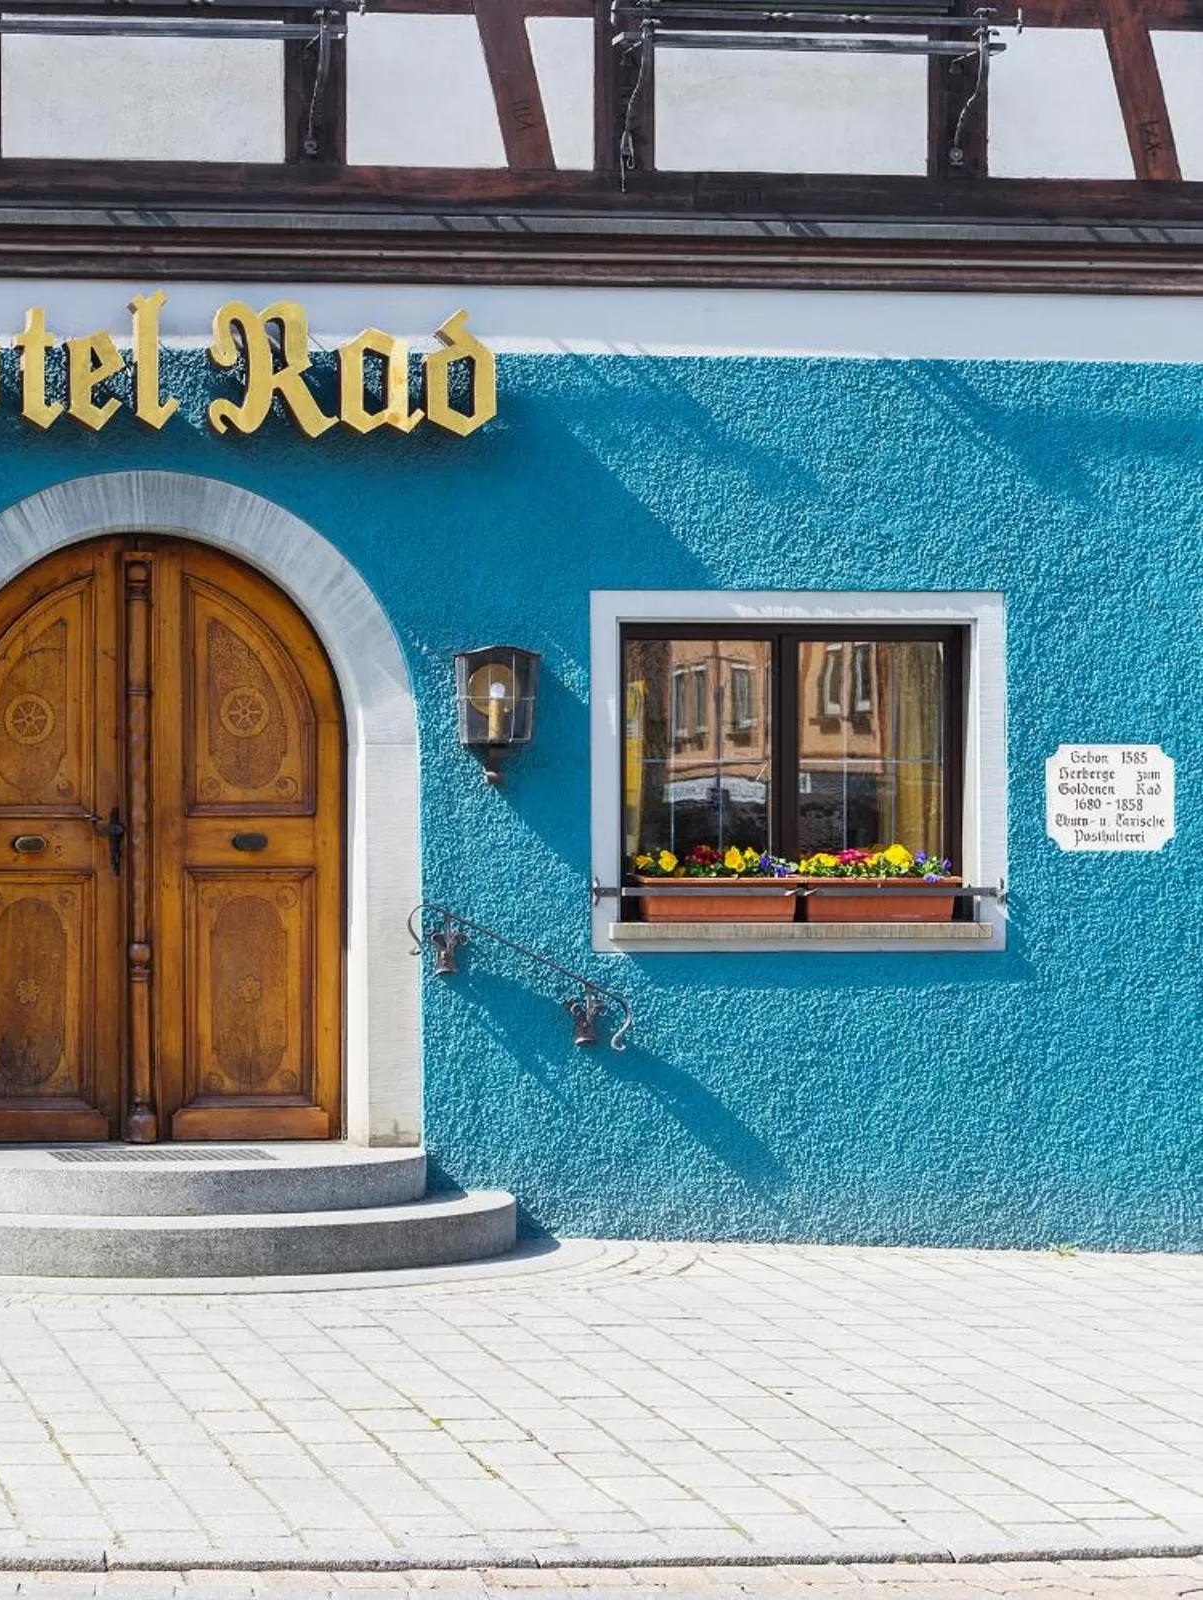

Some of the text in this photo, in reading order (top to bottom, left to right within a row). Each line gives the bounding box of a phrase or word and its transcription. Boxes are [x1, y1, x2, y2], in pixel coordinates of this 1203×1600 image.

[206, 300, 497, 438] Rad
[1121, 751, 1148, 764] 1585
[1059, 767, 1161, 782] Herberge zum
[1058, 782, 1162, 795] Goldenen Rad
[1116, 798, 1143, 811] 1858
